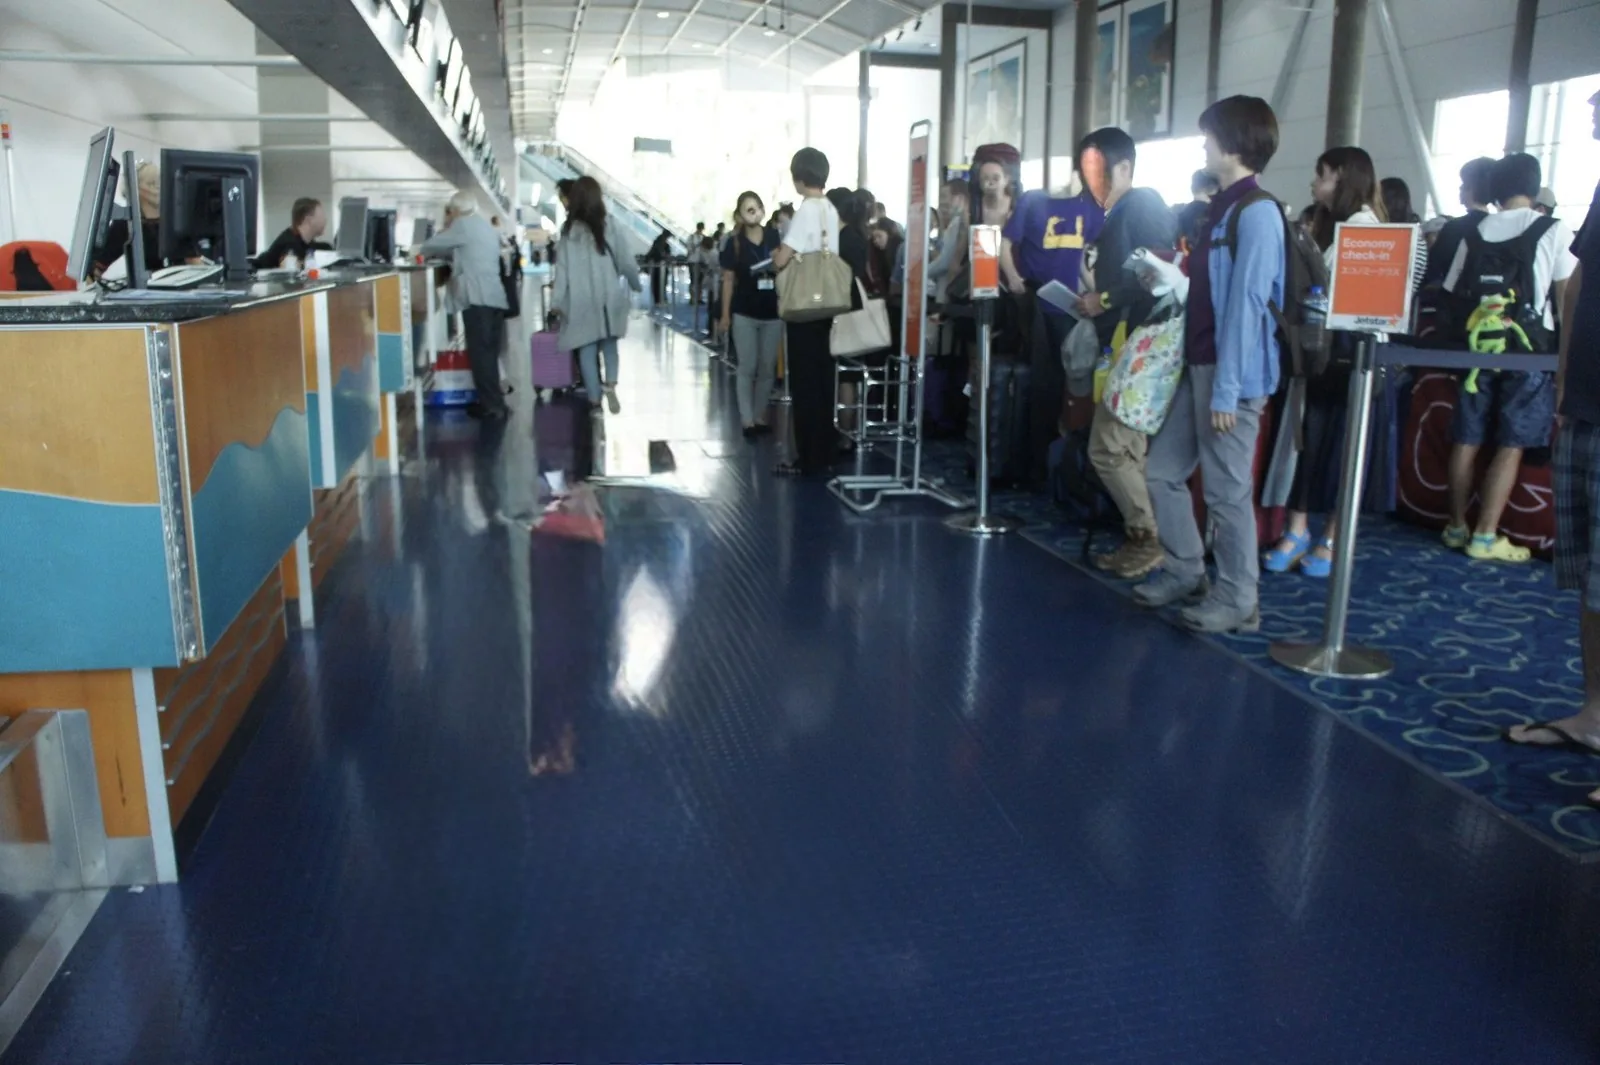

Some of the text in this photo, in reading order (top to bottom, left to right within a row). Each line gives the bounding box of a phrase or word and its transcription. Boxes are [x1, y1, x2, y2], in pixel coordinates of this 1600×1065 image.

[1342, 237, 1396, 250] Economy
[1341, 249, 1390, 260] check-in
[1353, 316, 1387, 326] Jetstar
